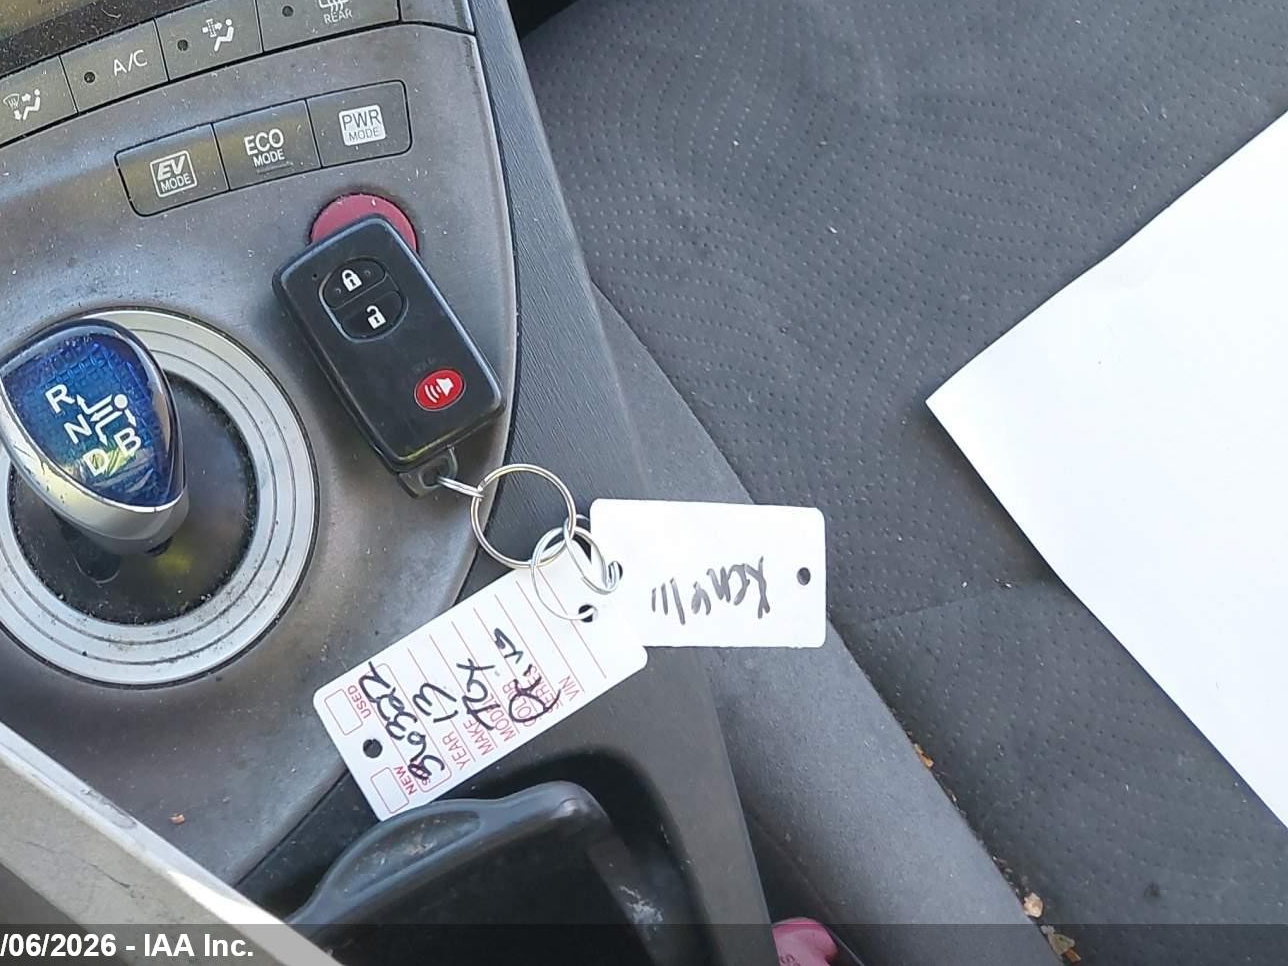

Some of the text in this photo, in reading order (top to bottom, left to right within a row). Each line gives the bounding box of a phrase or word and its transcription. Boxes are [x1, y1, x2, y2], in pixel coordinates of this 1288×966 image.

[323, 8, 353, 25] REAR
[112, 49, 148, 76] A/C
[341, 108, 382, 132] PWR
[243, 128, 285, 156] ECO
[347, 127, 381, 143] MODE
[157, 155, 186, 181] EV
[253, 148, 286, 168] MODE
[160, 172, 192, 193] MODE
[44, 384, 76, 414] R
[64, 414, 93, 444] N
[113, 427, 142, 454] B
[82, 448, 109, 477] D
[346, 684, 372, 720] USED
[557, 675, 580, 702] VIN
[441, 730, 471, 771] YEAR
[462, 719, 494, 756] MAKE
[393, 765, 419, 795] NEW
